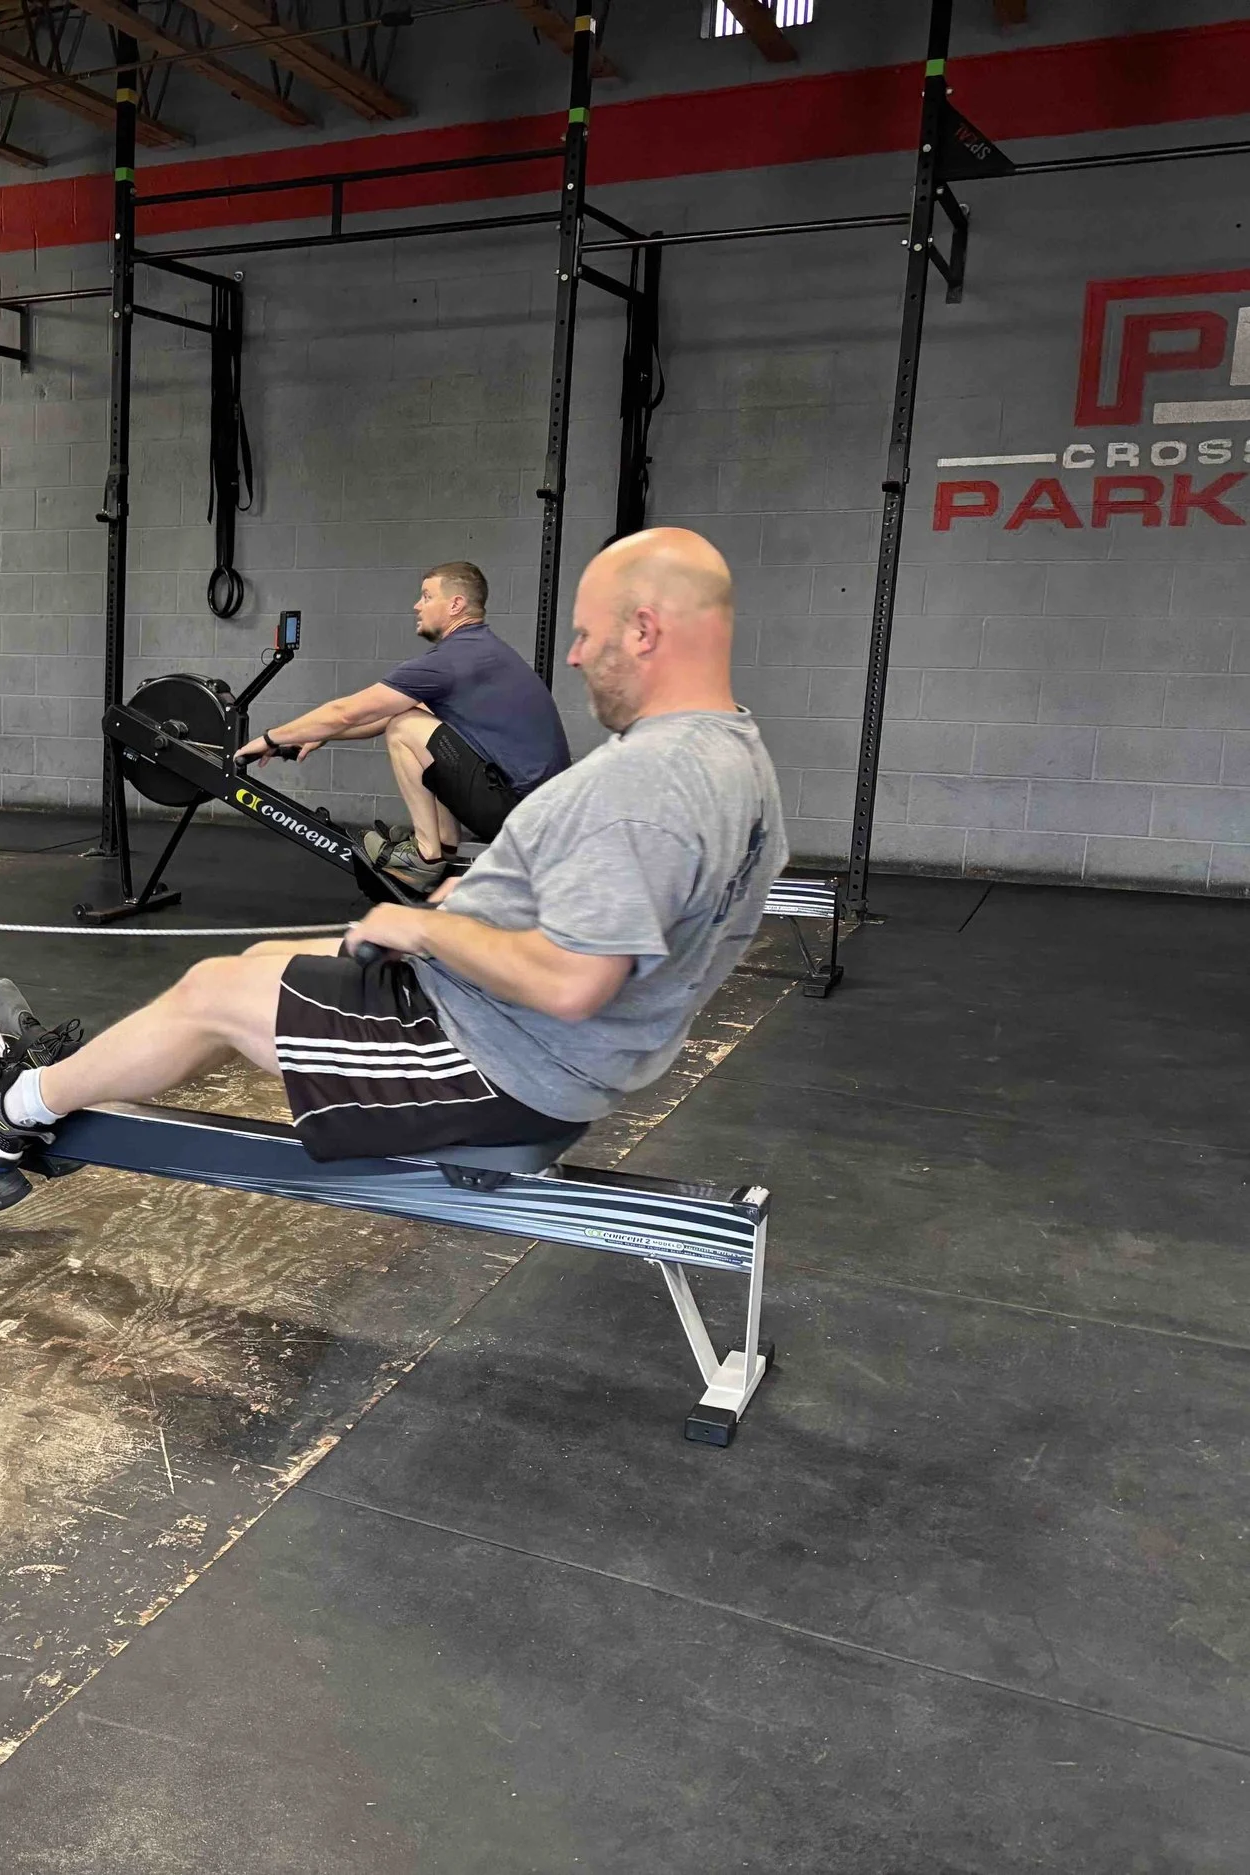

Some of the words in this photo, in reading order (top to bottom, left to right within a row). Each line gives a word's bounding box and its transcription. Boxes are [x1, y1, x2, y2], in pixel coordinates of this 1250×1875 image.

[1062, 438, 1250, 469] CROS
[932, 471, 1249, 531] PARK
[261, 804, 340, 854] concept
[340, 848, 353, 861] 2
